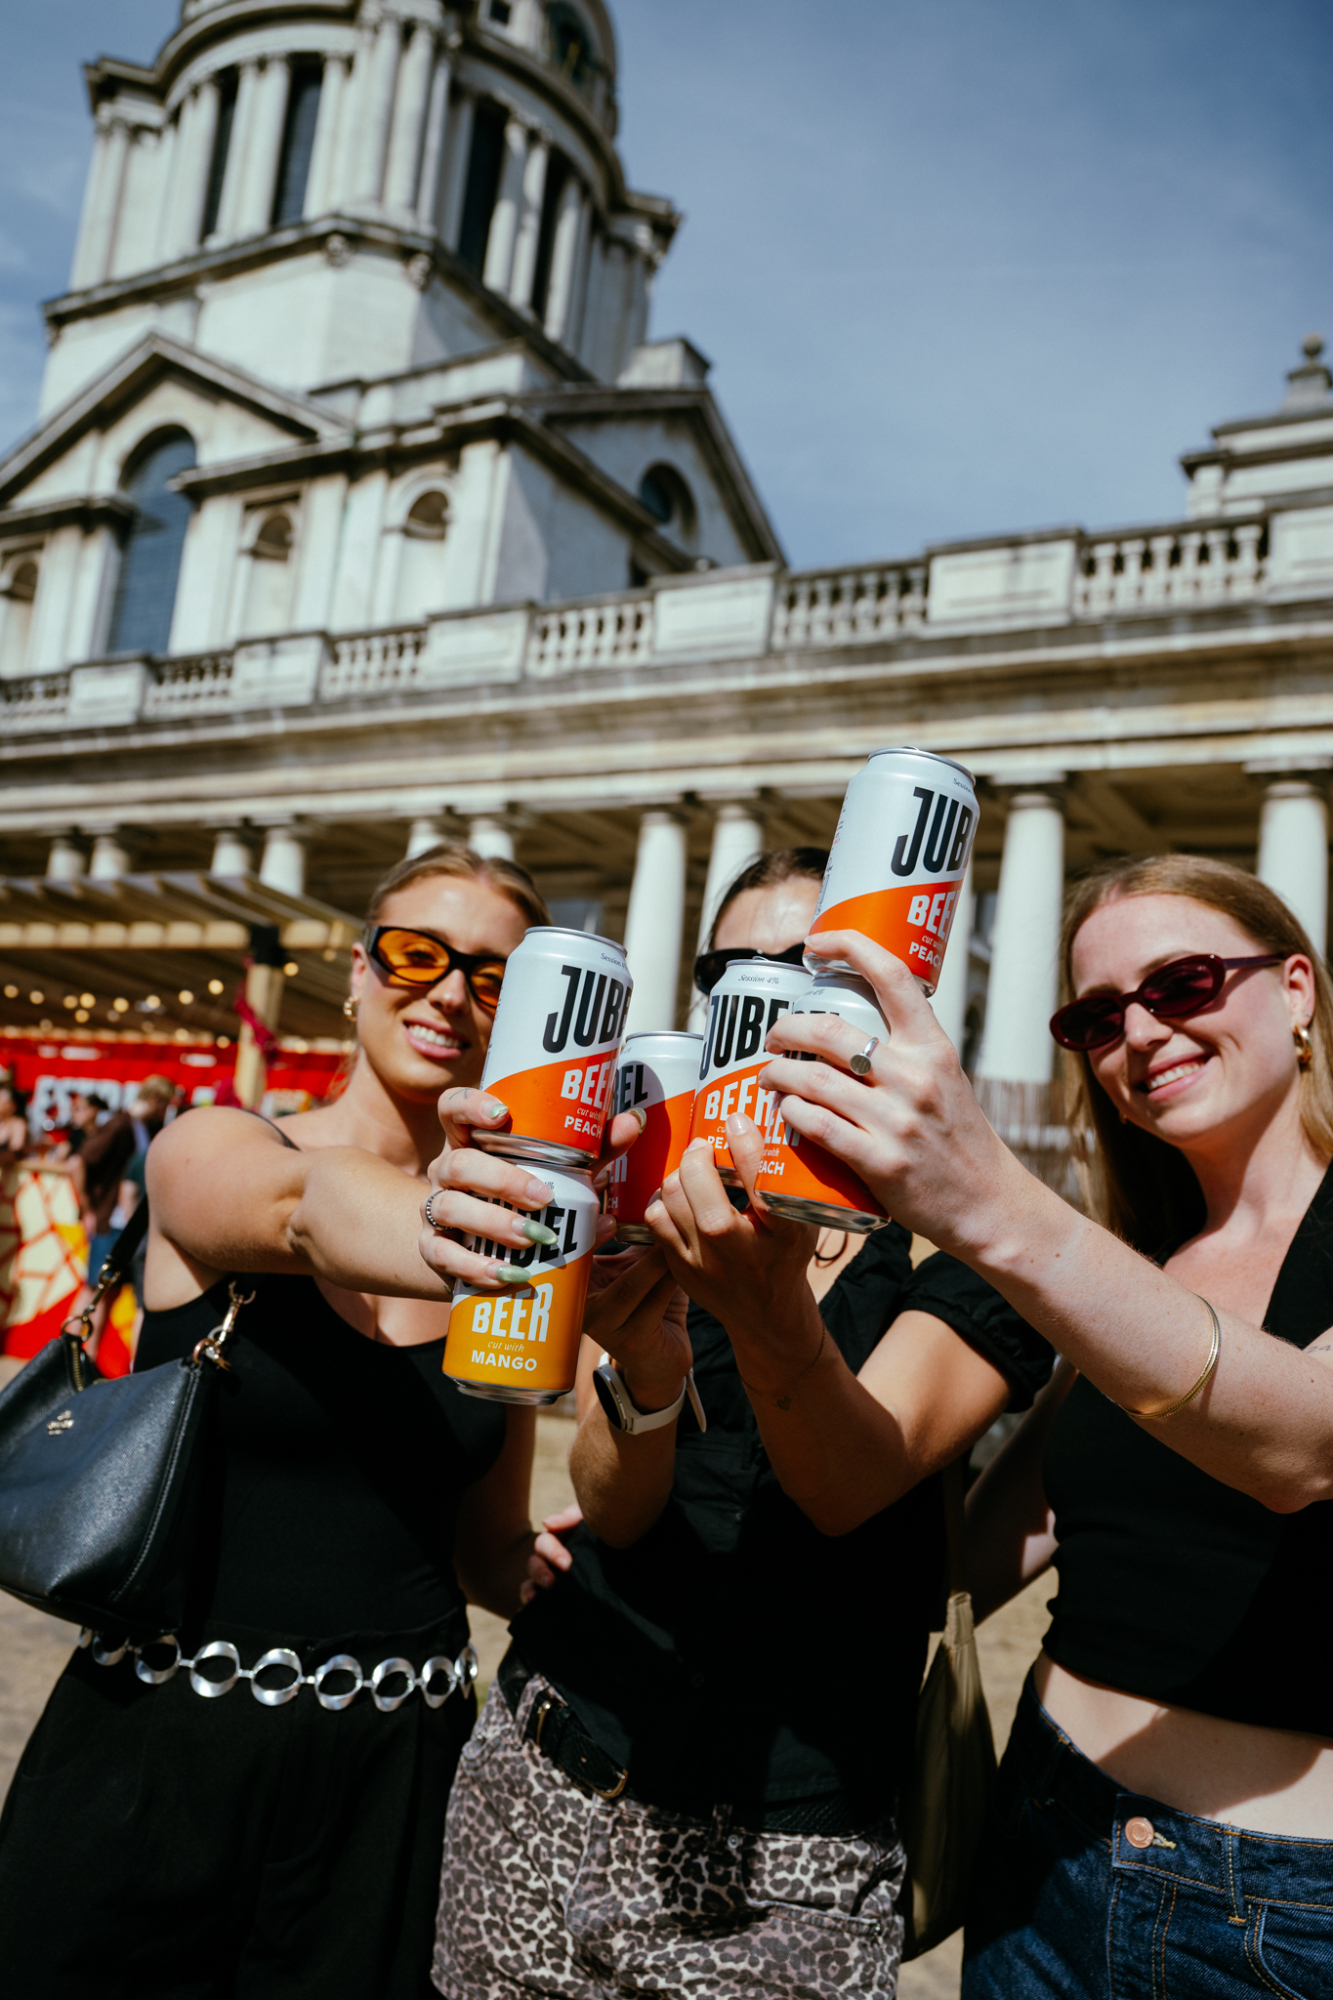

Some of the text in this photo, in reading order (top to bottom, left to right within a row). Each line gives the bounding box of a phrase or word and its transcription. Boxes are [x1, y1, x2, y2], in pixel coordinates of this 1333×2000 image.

[600, 952, 622, 968] Session
[738, 974, 765, 983] Session
[576, 1107, 589, 1117] cut
[564, 1115, 603, 1139] PEACH
[472, 1283, 553, 1343] BEER
[487, 1341, 525, 1353] cut with
[471, 1349, 537, 1371] MANGO
